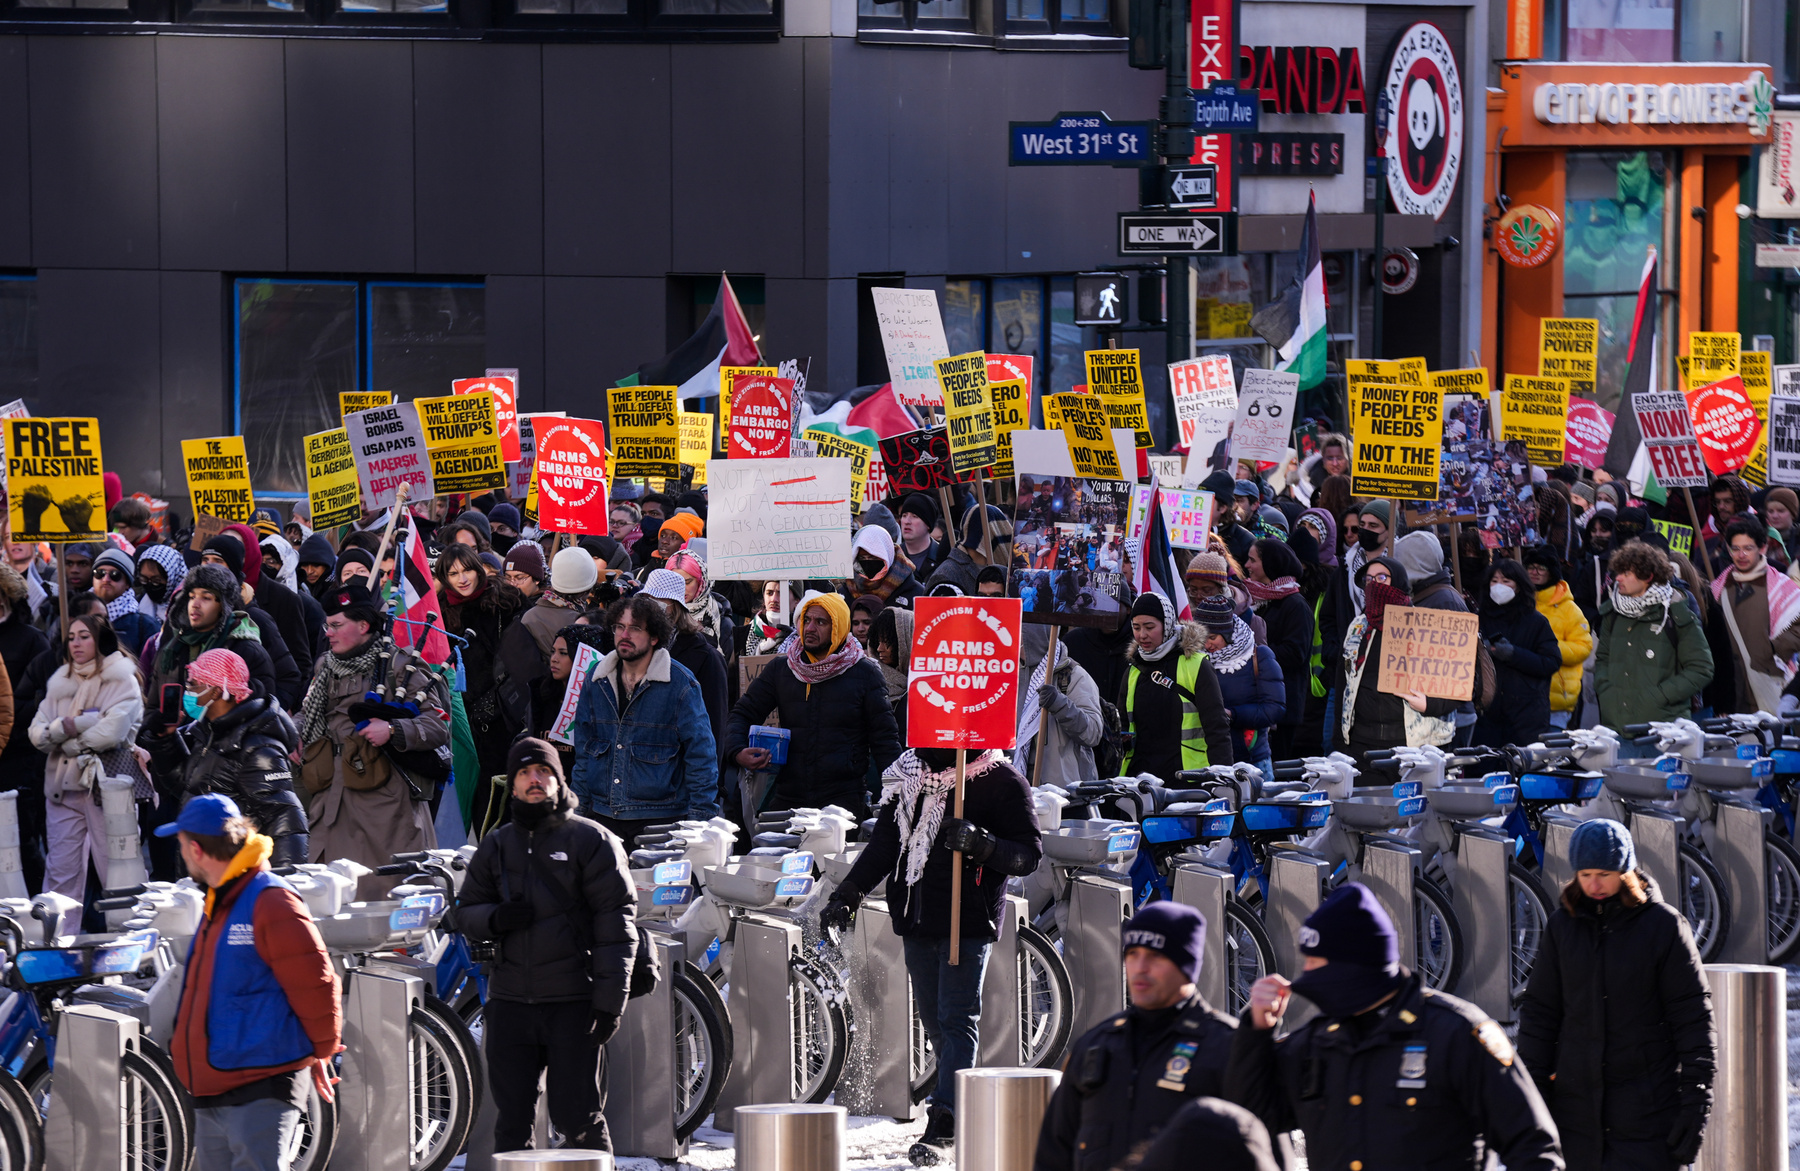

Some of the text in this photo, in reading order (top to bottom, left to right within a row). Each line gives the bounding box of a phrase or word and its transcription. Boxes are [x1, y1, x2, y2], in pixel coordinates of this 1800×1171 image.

[1389, 37, 1416, 116] PANDA
[1421, 30, 1461, 115] EXPRESS
[1535, 82, 1748, 124] CITY OF FLOWERS
[1196, 102, 1252, 127] Eighth Ave
[1060, 119, 1100, 128] 200 262
[1022, 132, 1138, 155] West 31st St
[1176, 180, 1208, 194] ONE WAY
[1138, 228, 1207, 241] ONE WAY
[1545, 320, 1594, 332] WORKERS
[1544, 339, 1592, 353] POWER
[939, 356, 984, 376] MONEY FOR
[1089, 353, 1136, 366] THE PEOPLE
[1365, 362, 1380, 374] THE
[1543, 358, 1592, 372] NOT THE
[943, 370, 986, 392] PEOPLE'S
[1091, 366, 1137, 384] UNITED
[1172, 359, 1232, 396] FREE
[611, 390, 673, 403] THE PEOPLE
[952, 388, 983, 408] NEEDS
[1110, 384, 1139, 395] DEFEND
[1362, 388, 1438, 405] MONEY FOR
[344, 395, 388, 405] MONEY FOR
[424, 397, 490, 415] THE PEOPLE
[613, 402, 674, 413] WILL DEFEAT
[1086, 398, 1101, 411] FOR
[1206, 397, 1235, 408] THE
[1634, 394, 1684, 405] END THE
[362, 408, 400, 425] ISRAEL
[426, 409, 490, 426] WILL DEFEAT
[744, 404, 780, 417] ARMS
[1360, 403, 1437, 422] PEOPLE'S
[1507, 402, 1563, 417] LA AGENDA
[613, 413, 675, 427] TRUMP'S
[732, 416, 789, 430] EMBARGO
[950, 412, 992, 437] NOT THE
[1240, 418, 1284, 430] ABOLISH
[1371, 419, 1424, 438] NEEDS
[1638, 409, 1693, 439] NOW!
[365, 421, 404, 438] BOMBS
[427, 421, 493, 442] TRUMP'S
[547, 424, 570, 440] ZIONISM
[748, 427, 776, 440] NOW
[12, 421, 92, 457] FREE
[206, 441, 222, 454] THE
[362, 436, 416, 456] USA PAYS
[615, 437, 676, 445] EXTREME-RIGHT
[808, 431, 868, 457] THE PEOPLE
[952, 430, 994, 449] WAR MACHINE!
[432, 445, 498, 460] EXTREME-RIGHT
[550, 450, 588, 464] ARMS
[616, 446, 676, 460] AGENDA!
[759, 445, 775, 456] FREE
[1093, 449, 1117, 466] THE
[1359, 444, 1434, 466] NOT THE
[9, 458, 99, 477] PALESTINE
[188, 455, 243, 471] MOVEMENT
[310, 457, 354, 478] LA AGENDA
[368, 453, 419, 475] MAERSK
[435, 455, 499, 475] AGENDA!
[538, 460, 603, 478] EMBARGO
[1358, 462, 1434, 477] WAR MACHINE!
[1648, 444, 1704, 479] FREE
[370, 470, 426, 495] DELIVERS
[553, 475, 584, 490] NOW
[713, 468, 749, 490] NOT
[752, 468, 767, 488] A
[1091, 480, 1131, 493] YOUR TAX
[1356, 480, 1370, 489] Party
[194, 488, 250, 504] PALESTINE
[314, 493, 357, 514] DE TRUMP!
[569, 484, 599, 508] FREE GAZA
[722, 492, 772, 513] NOT A
[756, 512, 849, 532] A GENOCIDE
[1169, 510, 1204, 526] THE
[712, 535, 832, 557] END APARTHEID
[723, 552, 829, 575] END OCCUPATION
[917, 606, 973, 646] END ZIONISM
[1404, 611, 1435, 628] TREE
[1440, 615, 1479, 636] LIBERTY
[1390, 626, 1469, 648] WATERED
[936, 640, 995, 656] ARMS
[1406, 642, 1458, 660] BLOOD
[914, 657, 1015, 674] EMBARGO
[1386, 654, 1472, 680] PATRIOTS
[940, 674, 989, 690] NOW
[1393, 672, 1469, 698] TYRANTS
[962, 681, 1010, 714] FREE GAZA
[1124, 931, 1166, 949] NYPD
